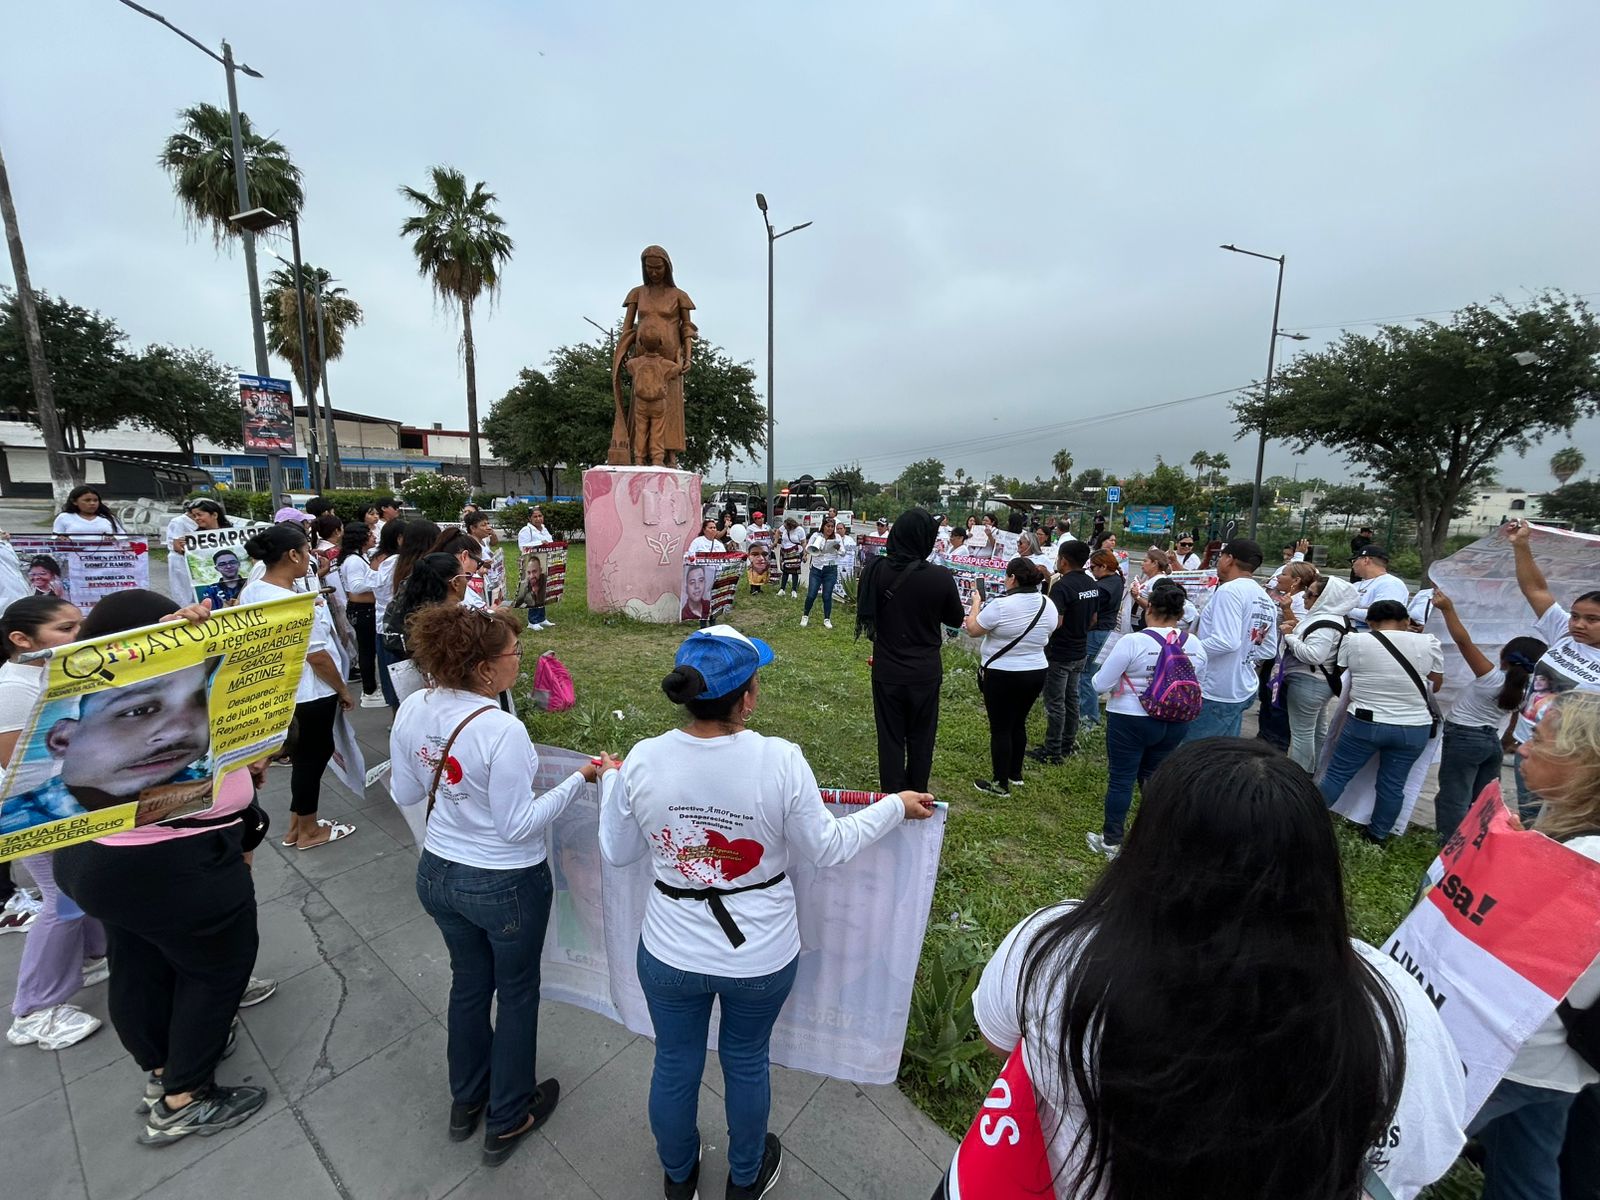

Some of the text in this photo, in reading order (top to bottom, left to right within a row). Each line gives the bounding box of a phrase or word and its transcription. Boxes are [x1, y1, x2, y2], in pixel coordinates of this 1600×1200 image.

[207, 641, 217, 652] a
[222, 626, 274, 650] regresar
[276, 623, 283, 634] a
[241, 652, 284, 672] GARCIA
[228, 664, 286, 692] MARTINEZ
[226, 709, 238, 721] de
[238, 705, 258, 719] julio
[259, 701, 272, 710] del
[274, 692, 293, 704] 2021
[679, 813, 734, 825] Desaparecidos
[705, 805, 731, 816] Amor
[0, 818, 124, 856] BRAZO DERECHO
[4, 817, 90, 847] TATUAJE EN
[691, 819, 733, 831] Tamaulipas
